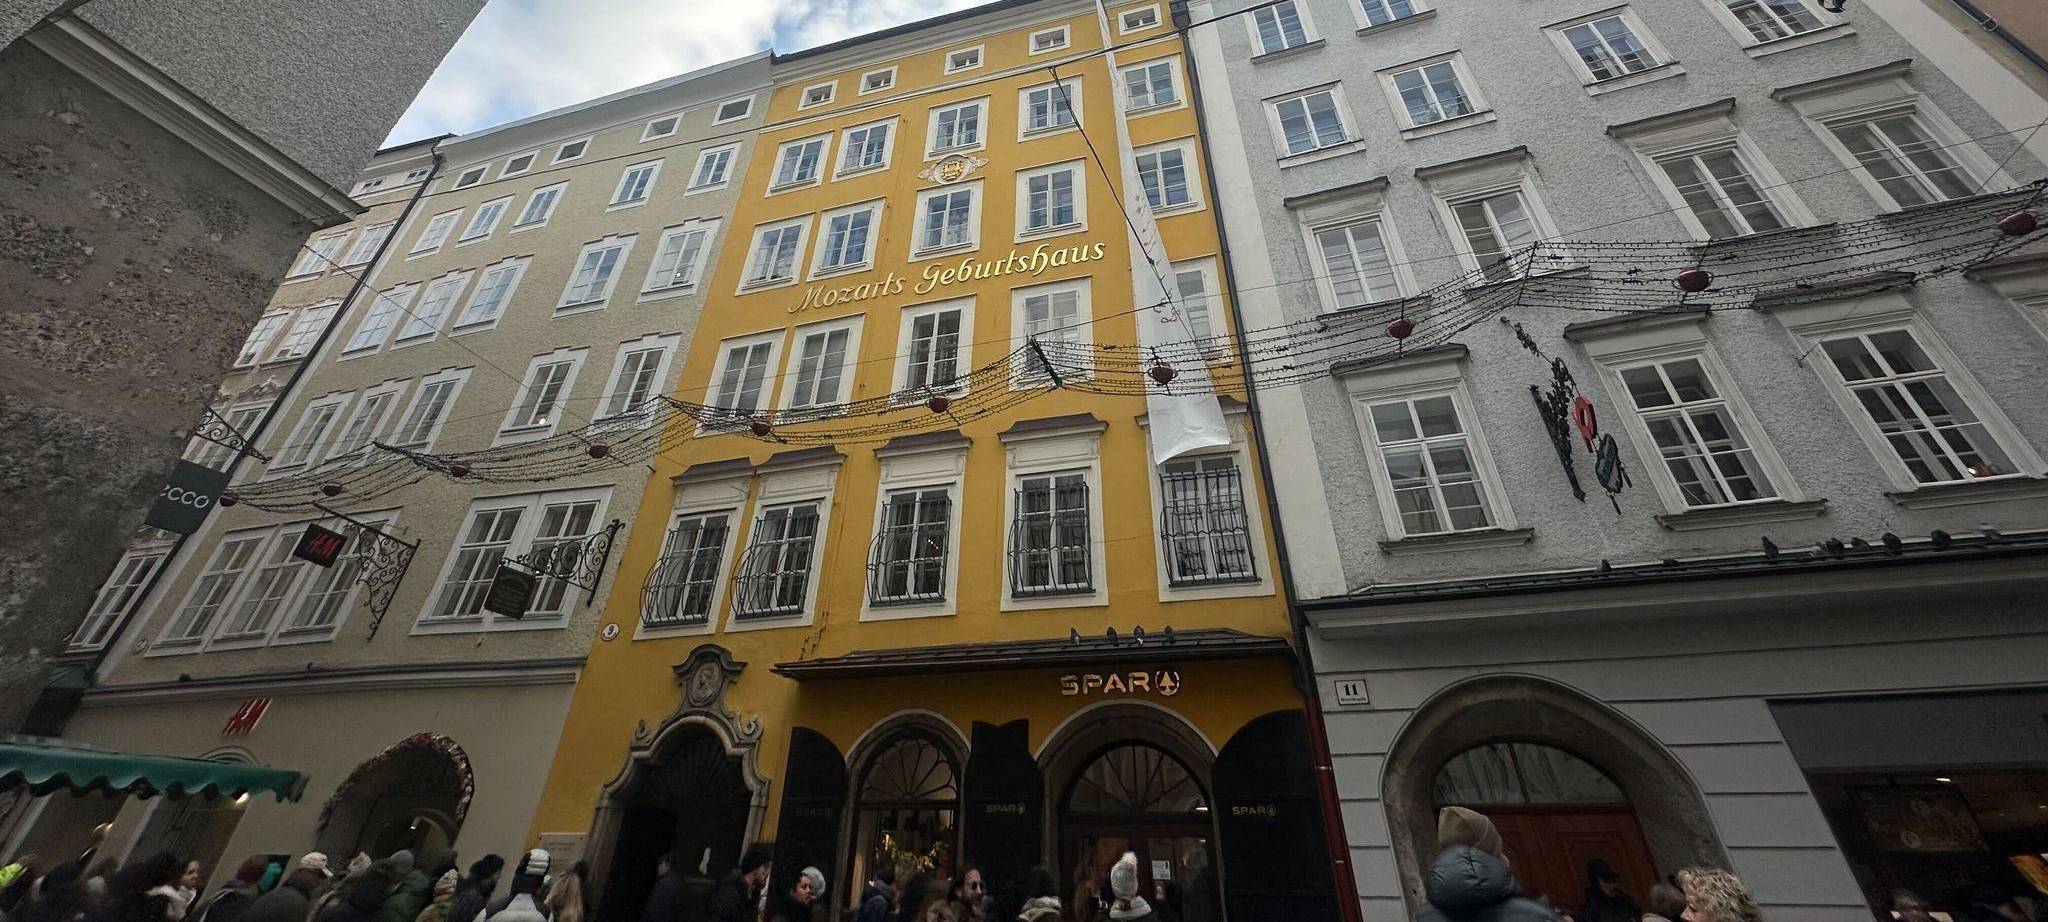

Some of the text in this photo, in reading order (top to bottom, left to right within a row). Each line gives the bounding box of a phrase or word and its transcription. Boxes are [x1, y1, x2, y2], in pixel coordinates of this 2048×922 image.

[788, 241, 1106, 313] Mozarts Geburtshaus
[604, 625, 614, 636] 9
[1060, 672, 1151, 696] SPAR
[1344, 683, 1358, 696] 11
[1232, 806, 1266, 816] SPAR
